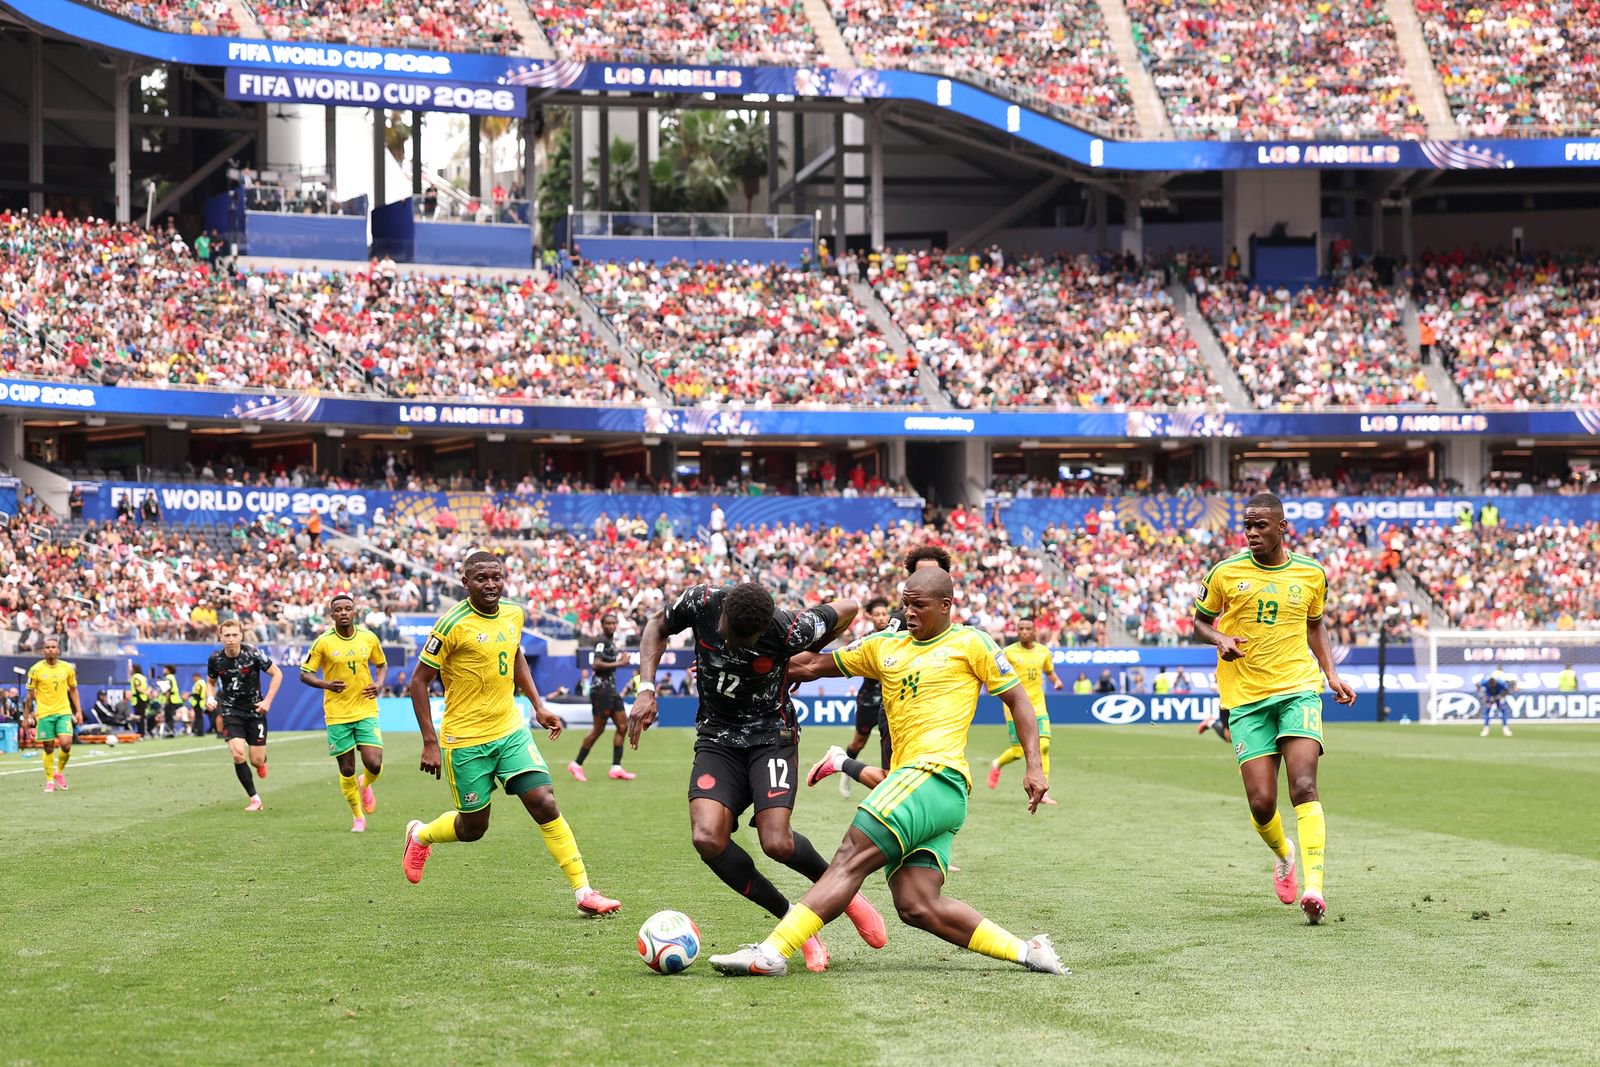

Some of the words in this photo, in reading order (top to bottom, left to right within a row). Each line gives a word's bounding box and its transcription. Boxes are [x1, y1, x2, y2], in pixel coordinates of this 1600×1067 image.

[228, 42, 272, 63] FIFA
[272, 45, 342, 66] WORLD
[343, 50, 383, 70] CUP
[383, 53, 451, 75] 2026
[604, 66, 646, 85] LOS
[648, 68, 742, 88] ANGELES
[239, 73, 292, 98] FIFA
[294, 75, 381, 103] WORLD
[383, 83, 432, 107] CUP
[433, 86, 515, 112] 2026
[1258, 145, 1301, 165] LOS
[1303, 145, 1400, 165] ANGELES
[9, 383, 40, 403] CUP
[399, 405, 436, 422] LOS
[440, 407, 524, 425] ANGELES
[1360, 415, 1398, 432] LOS
[1400, 415, 1487, 432] ANGELES
[161, 488, 244, 513] WORLD
[245, 490, 290, 513] CUP
[1281, 501, 1324, 519] OS
[1256, 598, 1279, 625] 13
[497, 650, 509, 676] 6
[1463, 647, 1494, 661] LOS
[347, 660, 357, 675] 4
[1027, 668, 1038, 681] 10
[52, 681, 59, 692] 7
[231, 676, 239, 690] 2
[717, 670, 740, 700] 12
[1302, 705, 1321, 730] 13
[257, 724, 265, 739] 2
[766, 757, 790, 790] 12
